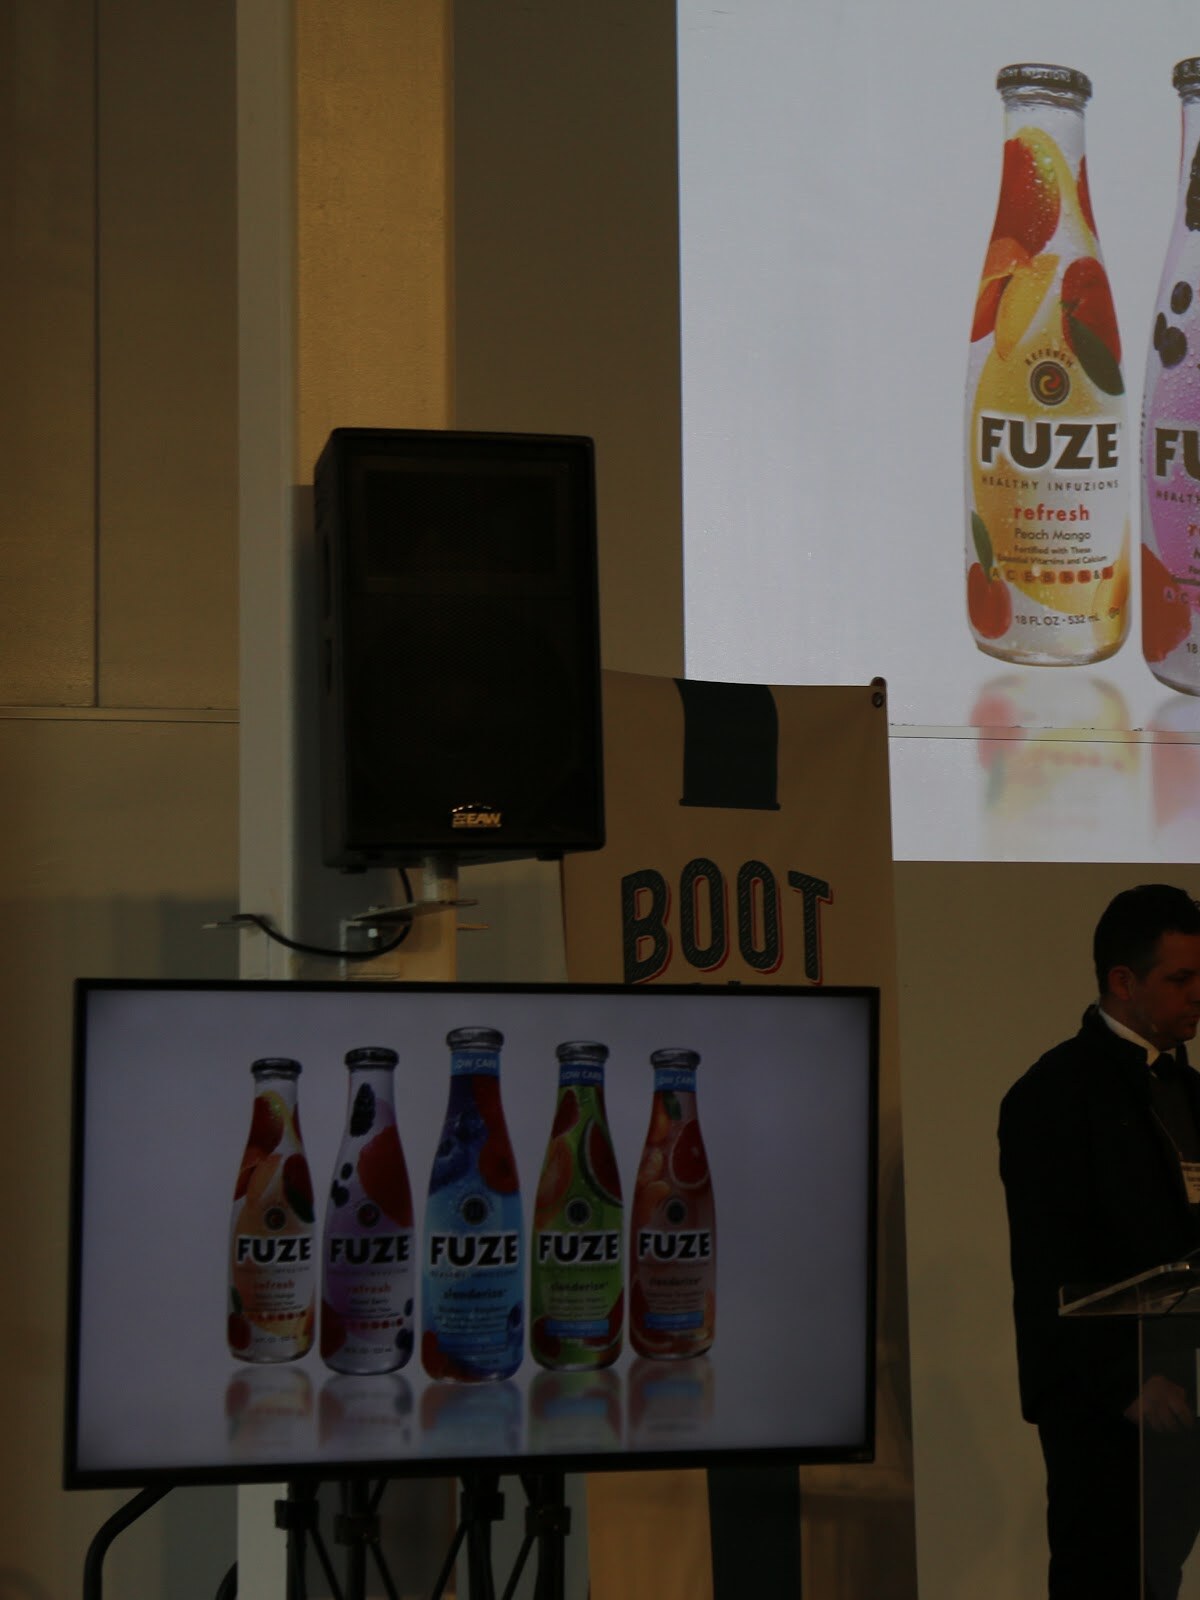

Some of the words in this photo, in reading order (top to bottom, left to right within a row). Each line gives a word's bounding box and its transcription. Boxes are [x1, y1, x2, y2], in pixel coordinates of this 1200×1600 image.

[981, 416, 1118, 469] FUZE
[982, 475, 1040, 490] HEALTHY
[1048, 480, 1119, 491] INFUZIONS
[1014, 503, 1090, 521] refresh
[1015, 527, 1049, 540] Peach
[1053, 530, 1091, 542] Mango
[1015, 615, 1027, 625] 18
[1030, 616, 1041, 626] FL
[1043, 616, 1060, 626] OZ
[1068, 614, 1085, 625] 532
[1186, 642, 1198, 654] 18
[621, 857, 833, 986] BOOT
[238, 1237, 311, 1263] FUZE
[330, 1235, 409, 1264] FUZE
[431, 1235, 517, 1267] FUZE
[540, 1234, 618, 1262] FUZE
[640, 1232, 710, 1259] FUZE
